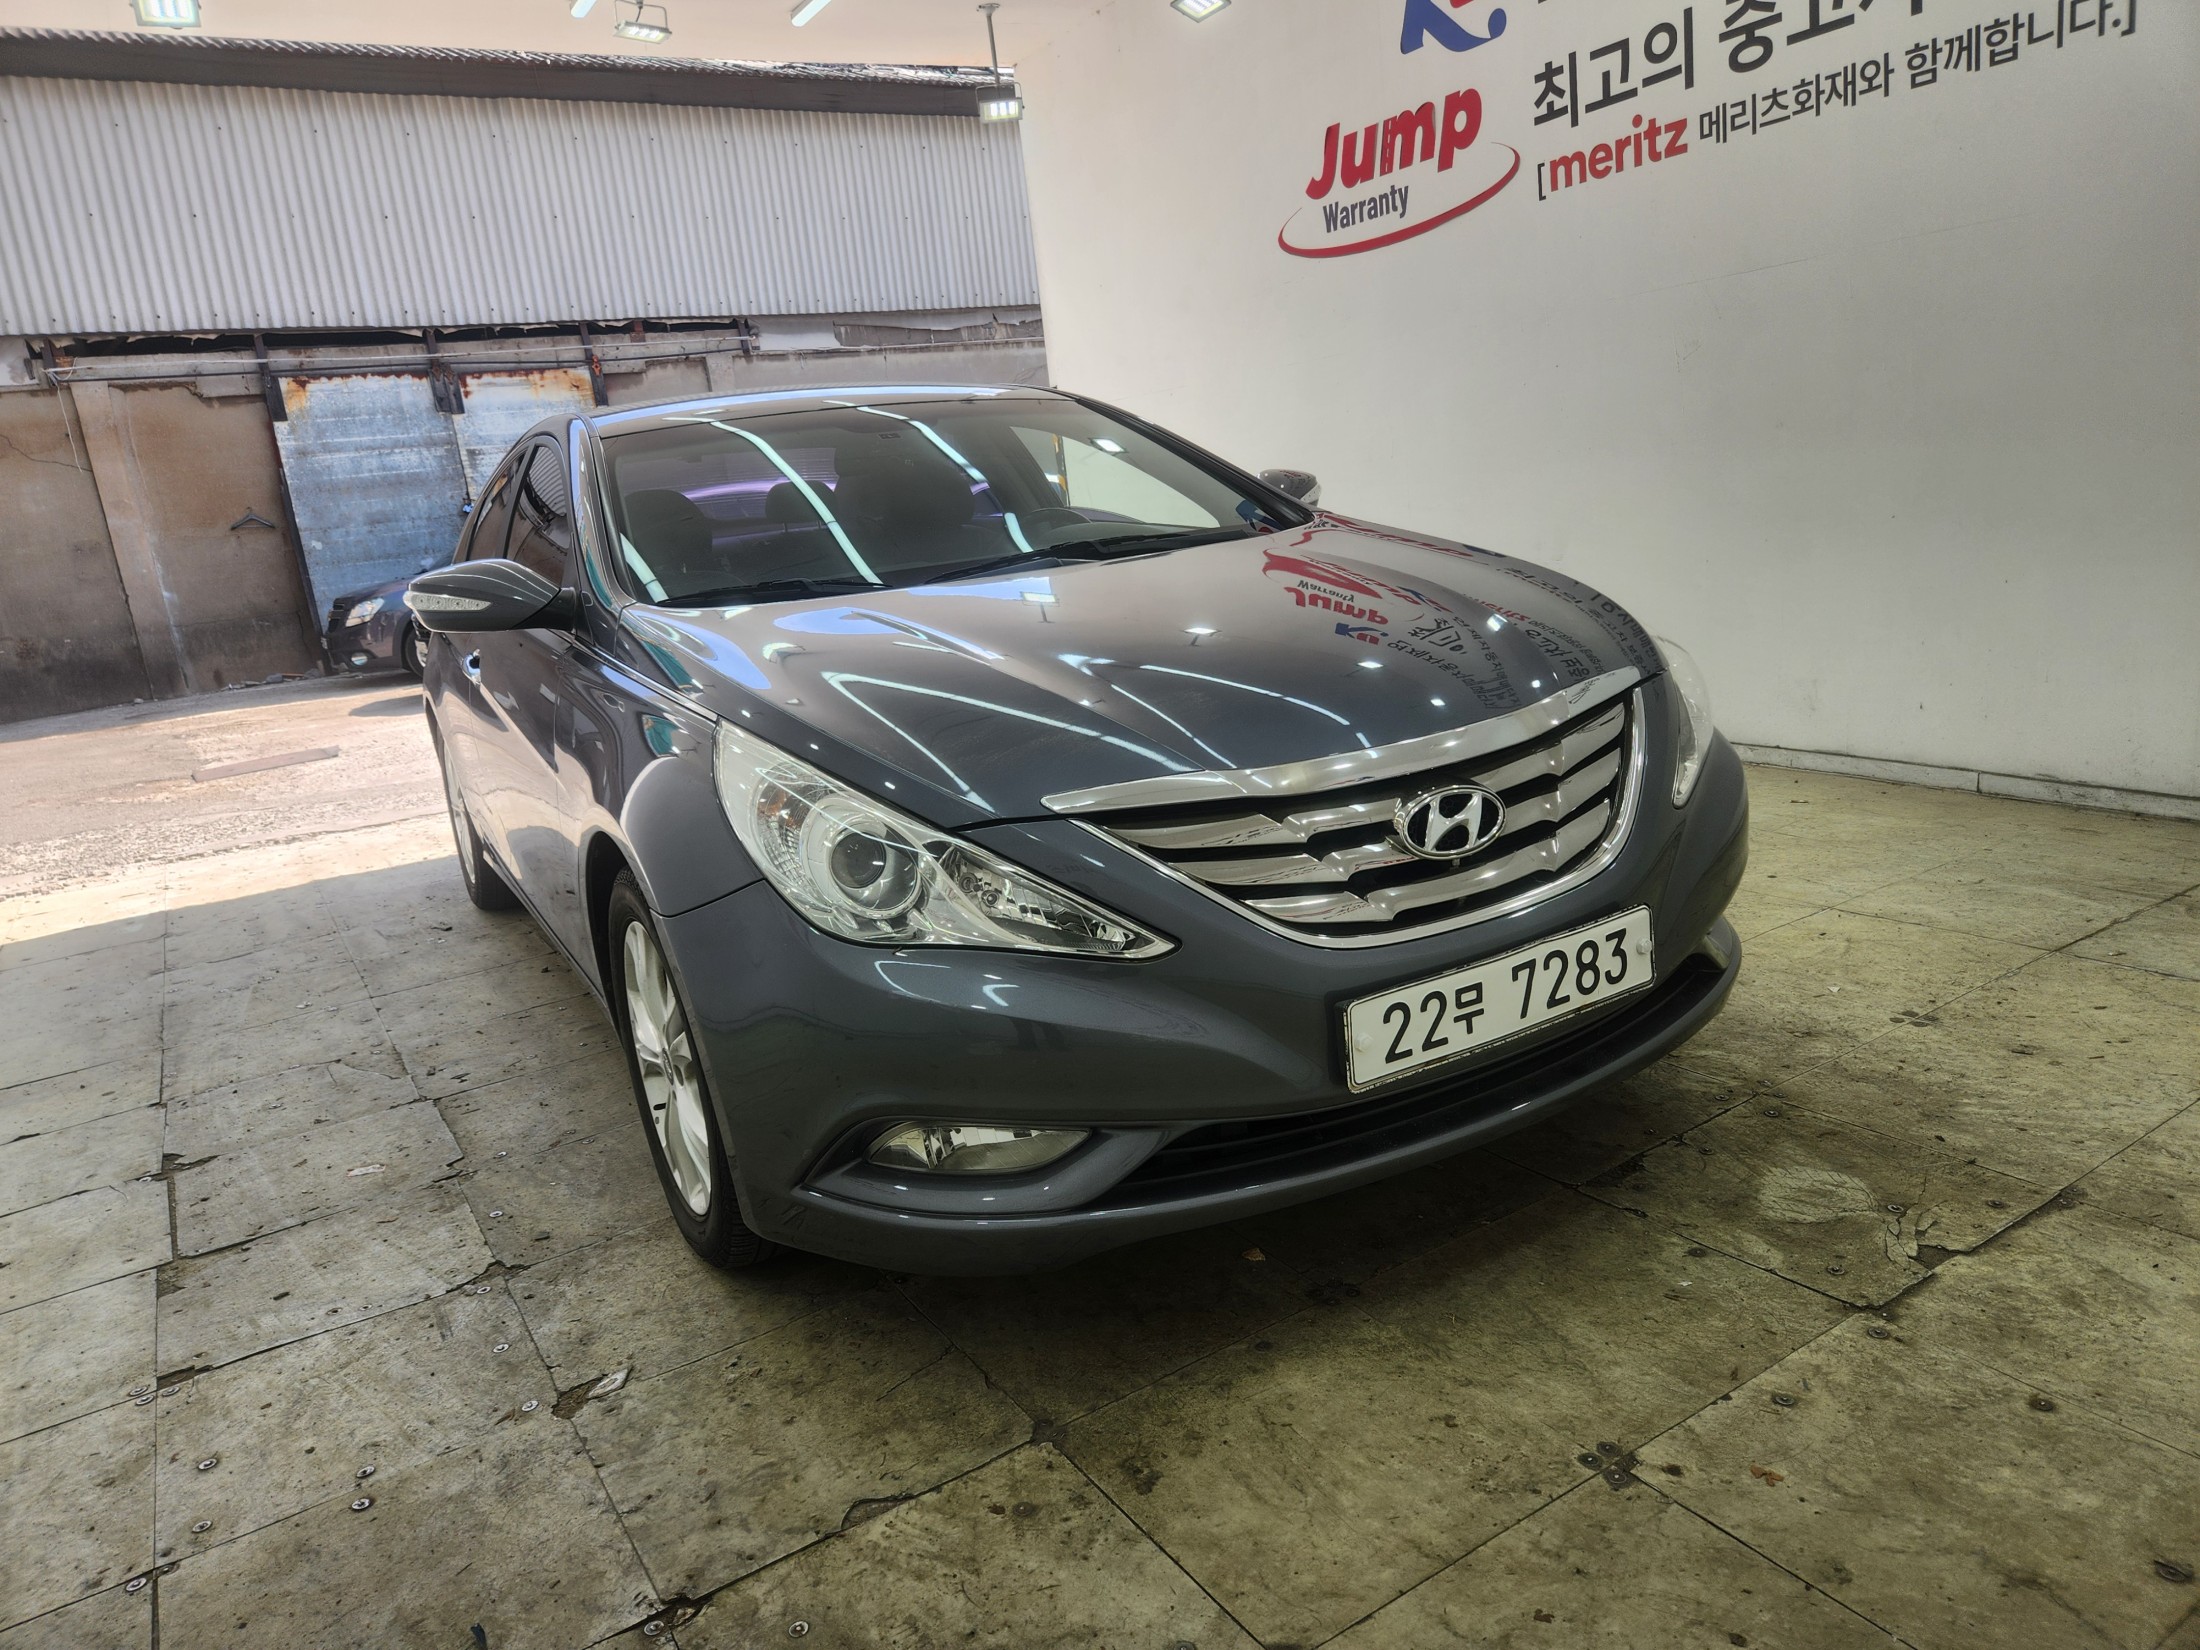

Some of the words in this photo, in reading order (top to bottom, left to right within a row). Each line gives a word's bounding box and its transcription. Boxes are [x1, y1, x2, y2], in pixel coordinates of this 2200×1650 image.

[1534, 6, 1694, 128] 최고의
[1699, 52, 1895, 144] 메리츠화재와
[1305, 88, 1482, 200] Jump
[1323, 184, 1409, 234] Warranty
[1382, 981, 1485, 1064] 22무
[1511, 927, 1628, 1020] 7283
